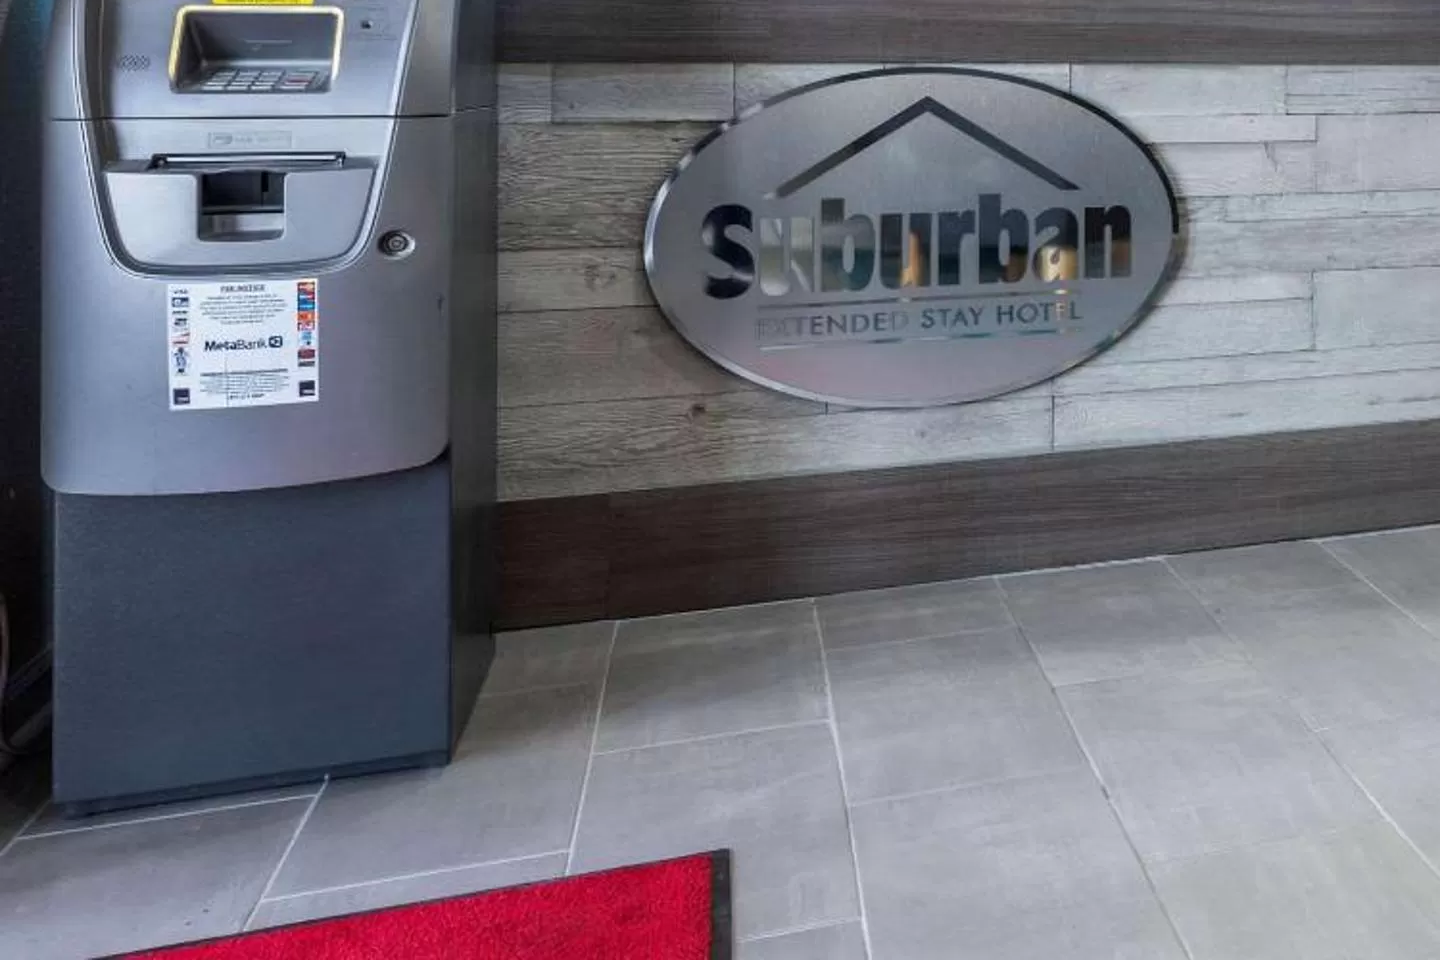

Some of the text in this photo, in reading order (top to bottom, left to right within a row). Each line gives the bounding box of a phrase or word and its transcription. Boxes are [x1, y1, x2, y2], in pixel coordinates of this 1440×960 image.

[701, 192, 1132, 300] Suburban
[755, 300, 1084, 342] EXTENDED STAY HOTEL
[204, 337, 268, 352] MetaBank
